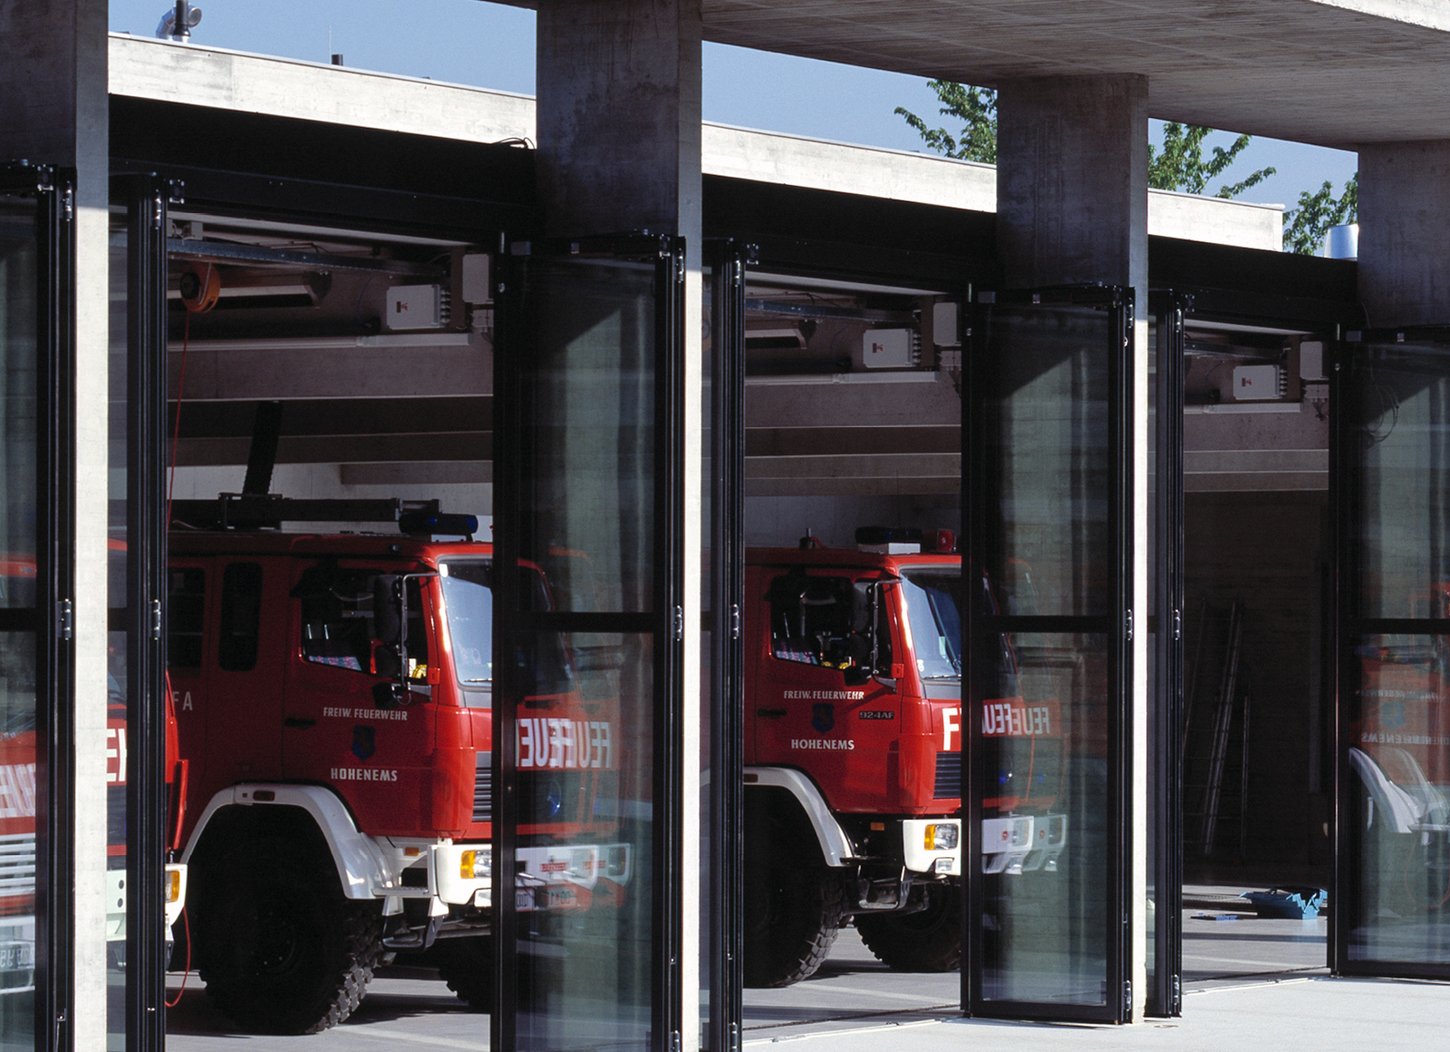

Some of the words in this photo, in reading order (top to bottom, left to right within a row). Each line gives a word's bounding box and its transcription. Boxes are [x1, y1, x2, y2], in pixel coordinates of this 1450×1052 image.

[783, 690, 812, 699] FREIW.
[813, 691, 865, 700] FEUERWEHR
[323, 707, 352, 718] FREIW.
[354, 708, 408, 721] FEUERWEHR
[942, 707, 961, 750] F
[791, 739, 855, 750] HOHENEMS
[330, 768, 398, 781] HOHENEMS
